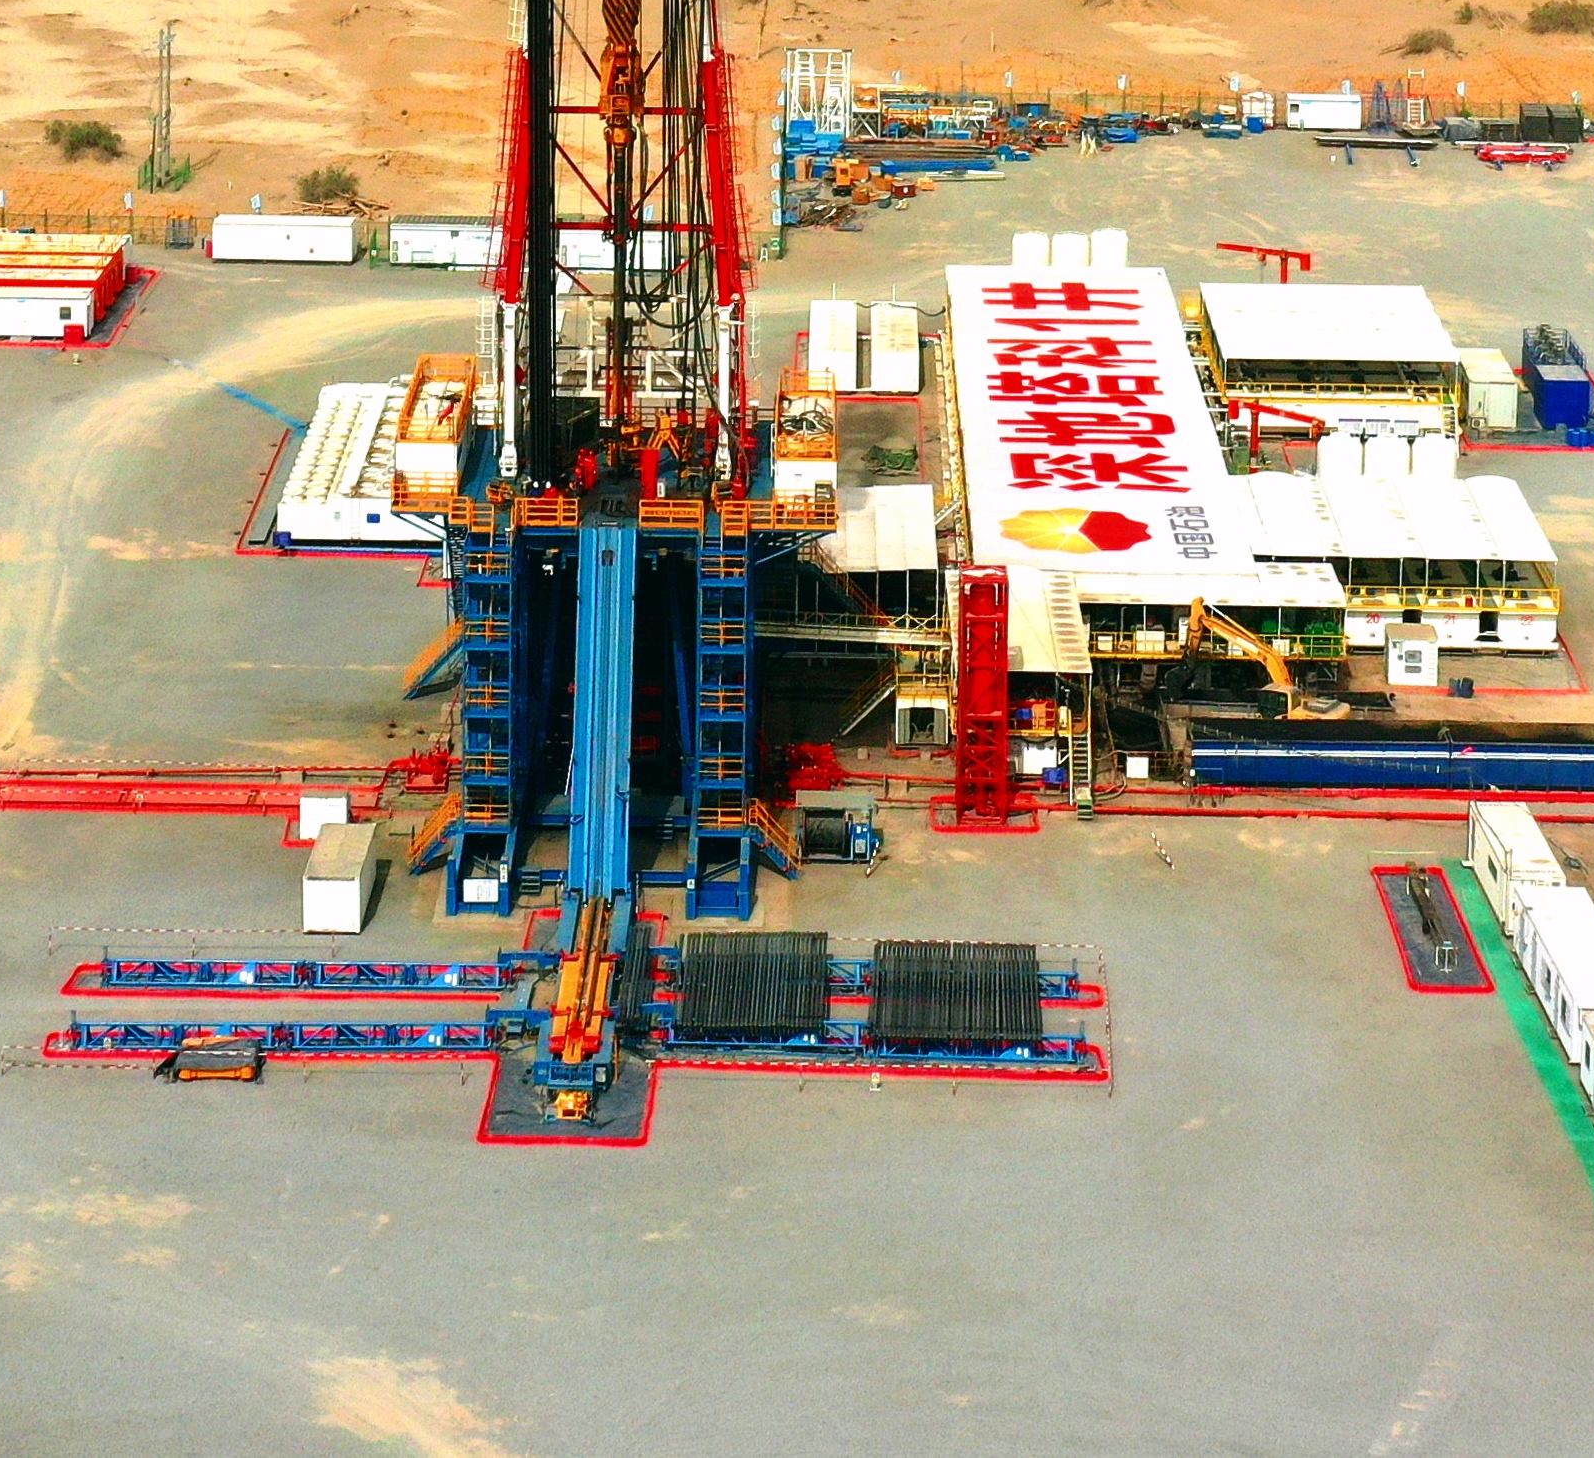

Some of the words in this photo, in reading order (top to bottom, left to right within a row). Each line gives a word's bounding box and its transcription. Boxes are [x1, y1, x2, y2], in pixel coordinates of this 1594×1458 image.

[982, 282, 1192, 493] 深地塔科1井
[1165, 506, 1218, 559] 中国石油
[1365, 613, 1381, 624] 20
[1520, 615, 1535, 626] 22
